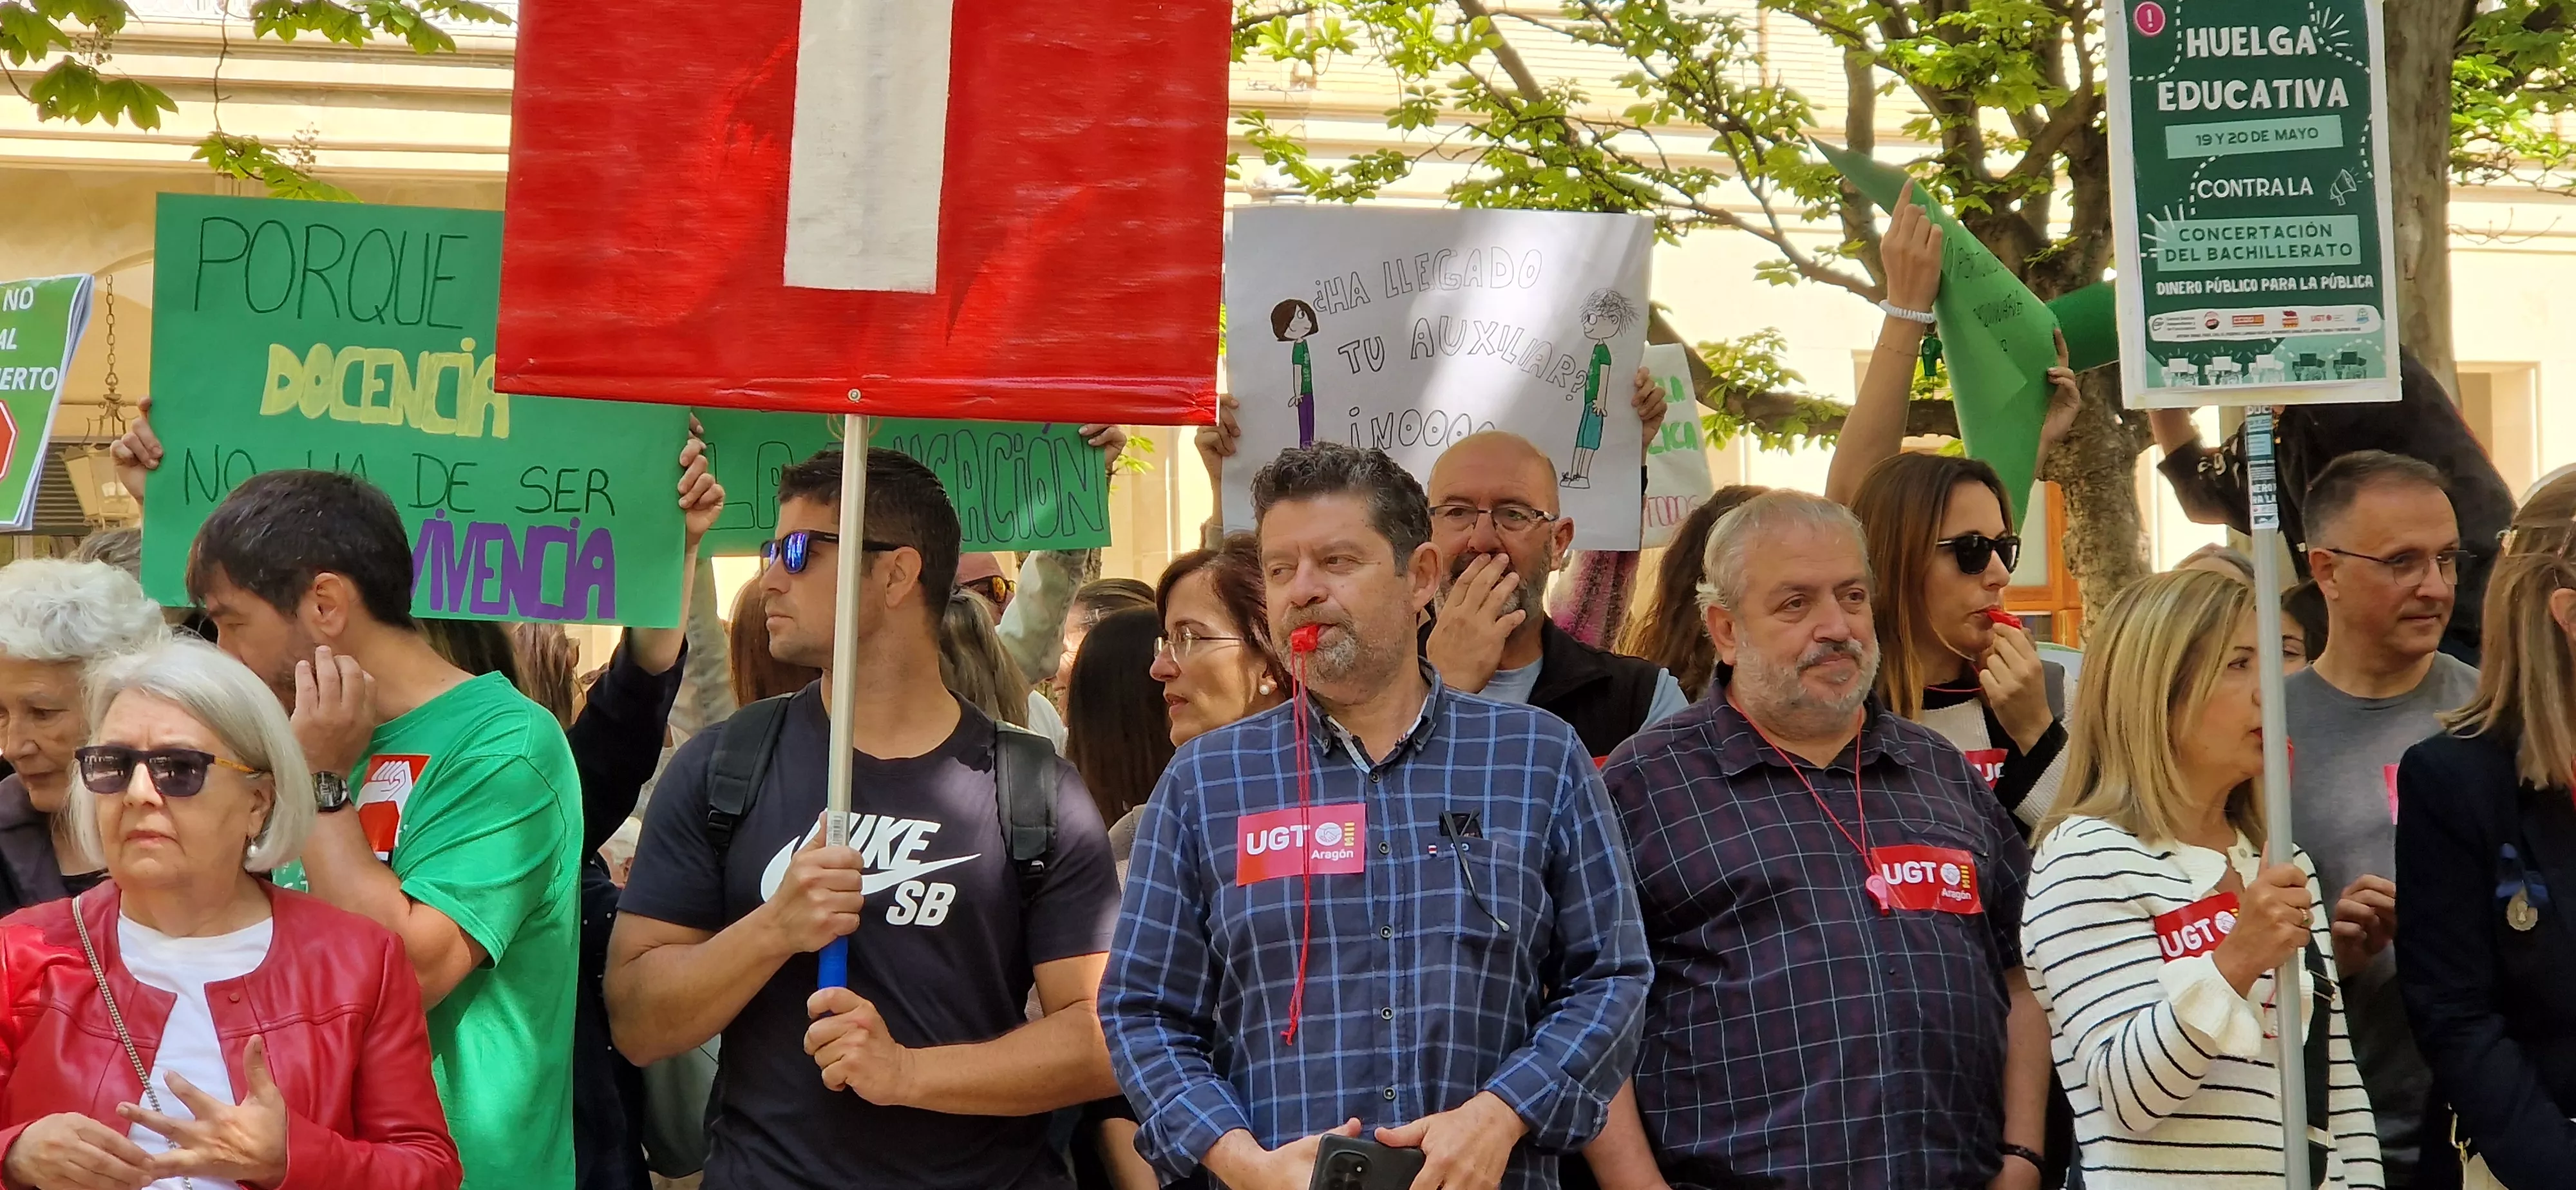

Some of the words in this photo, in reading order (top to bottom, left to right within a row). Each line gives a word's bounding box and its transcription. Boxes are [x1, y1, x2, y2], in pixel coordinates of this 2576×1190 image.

[2186, 25, 2318, 59] HUELGA
[2157, 77, 2349, 111] EDUCATIVA
[2195, 134, 2212, 147] 19
[2214, 133, 2225, 146] Y
[2228, 131, 2249, 145] 20
[2251, 129, 2269, 143] DE
[2275, 128, 2318, 142] MAYO
[2197, 178, 2286, 198] CONTRA
[2287, 177, 2314, 196] LA
[2179, 221, 2333, 242] CONCERTACIÓN
[2165, 247, 2201, 263] DEL
[2207, 243, 2353, 261] BACHILLERATO
[194, 216, 469, 329] PORQUE
[1313, 271, 1370, 314] ¿HA
[1383, 246, 1542, 298] LLEGADO
[2155, 279, 2203, 296] DINERO
[2206, 276, 2257, 294] PÚBLICO
[2261, 277, 2297, 292] PARA
[2300, 276, 2318, 290] LA
[2320, 272, 2374, 290] PÚBLICA
[3, 287, 33, 312] NO
[1338, 335, 1385, 373] TU
[1410, 316, 1588, 401] AUXILIAR?
[0, 366, 59, 391] ERTO
[259, 337, 510, 439] DOCENCIA
[1349, 406, 1495, 449] ¡NOOO
[408, 452, 478, 513] DE
[515, 466, 615, 516] SER
[825, 423, 1104, 543] ACIÓN
[1246, 824, 1311, 855] UGT
[1311, 848, 1354, 861] Aragón
[1881, 861, 1937, 885] UGT
[886, 880, 956, 927] SB
[1941, 887, 1972, 902] Aragón
[2160, 918, 2215, 958] UGT
